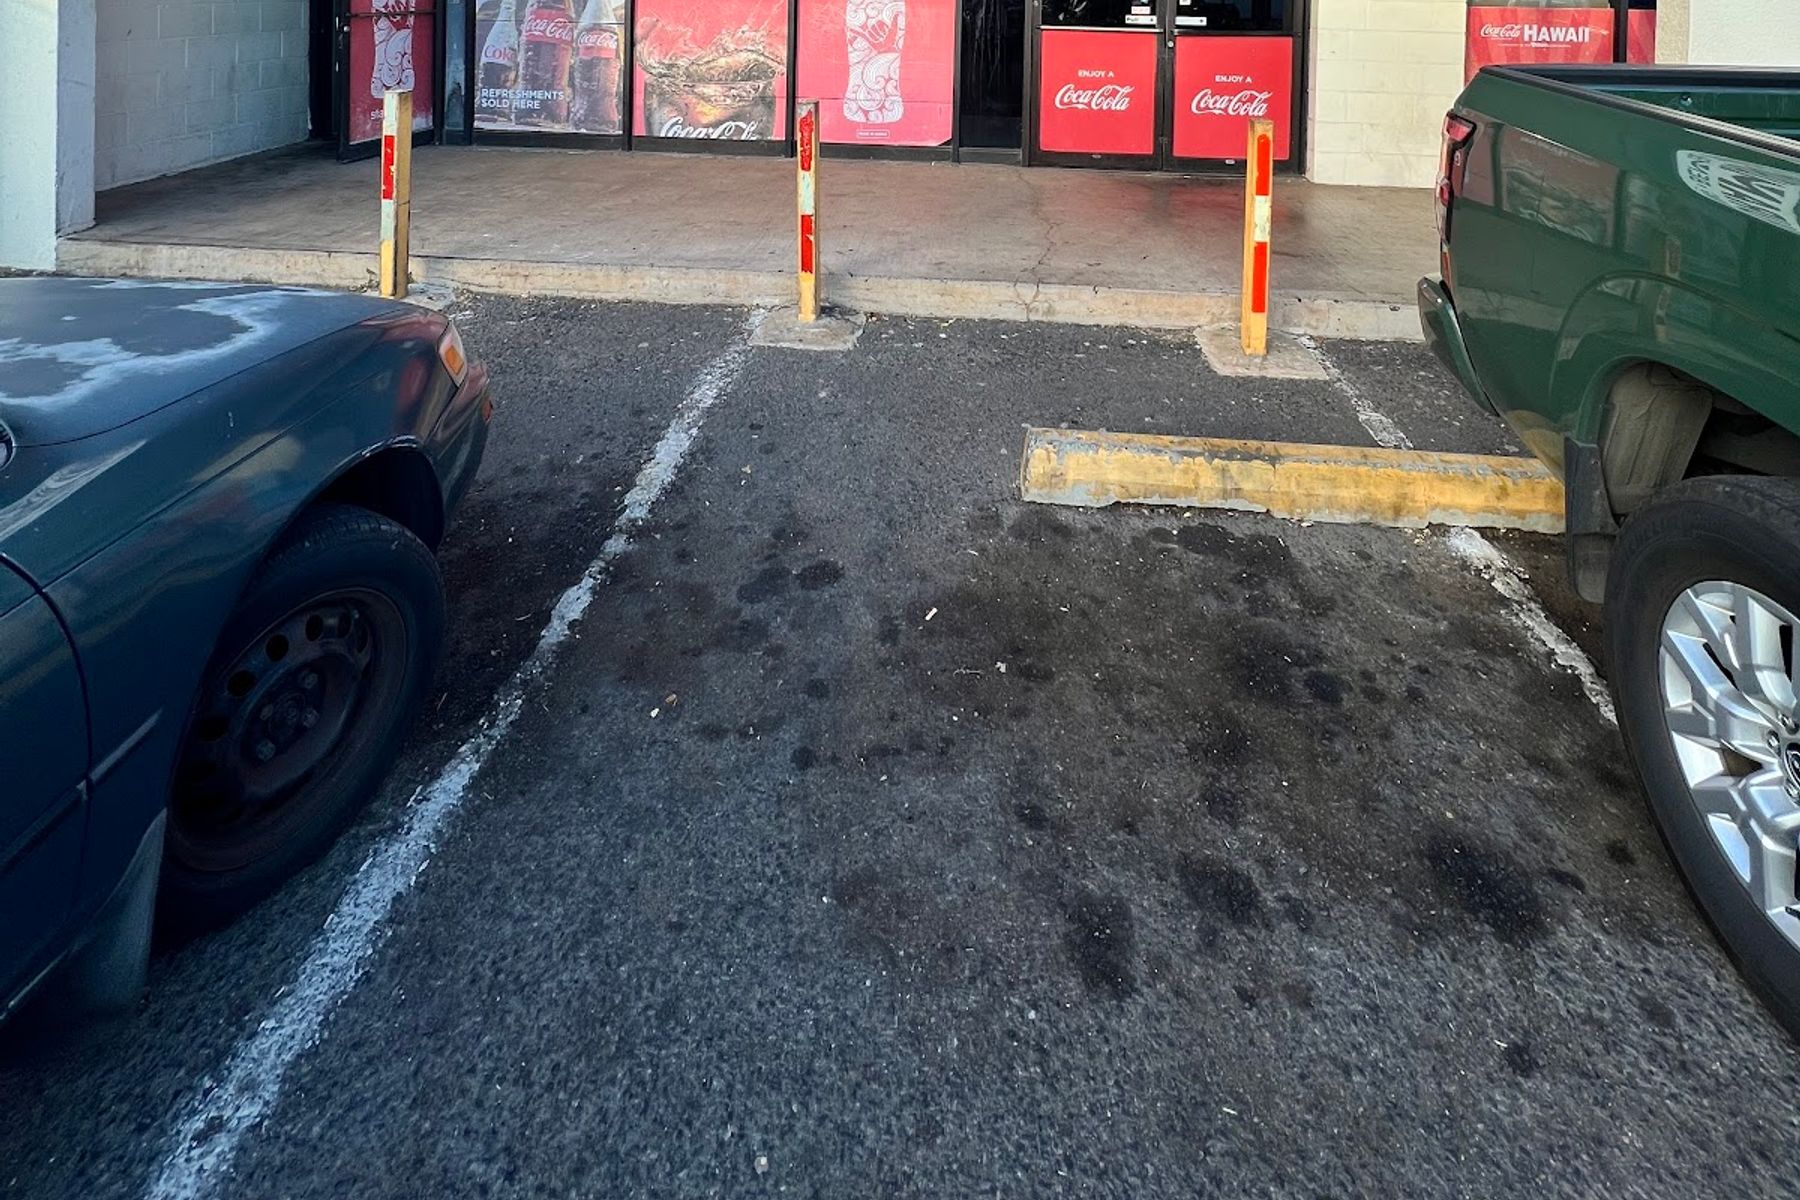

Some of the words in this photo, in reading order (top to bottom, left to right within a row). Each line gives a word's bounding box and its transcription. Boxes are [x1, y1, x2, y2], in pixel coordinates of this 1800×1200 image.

[1480, 24, 1522, 38] Coca-Cola
[1523, 24, 1590, 42] HAWAII
[1078, 70, 1105, 78] ENJOY
[1215, 75, 1244, 83] ENJOY
[481, 88, 565, 100] REFRESHMENTS
[1055, 84, 1135, 111] Coca-Cola
[481, 99, 510, 108] SOLD
[513, 100, 541, 109] HERE
[1191, 89, 1272, 116] Coca-Cola
[370, 109, 384, 120] sta
